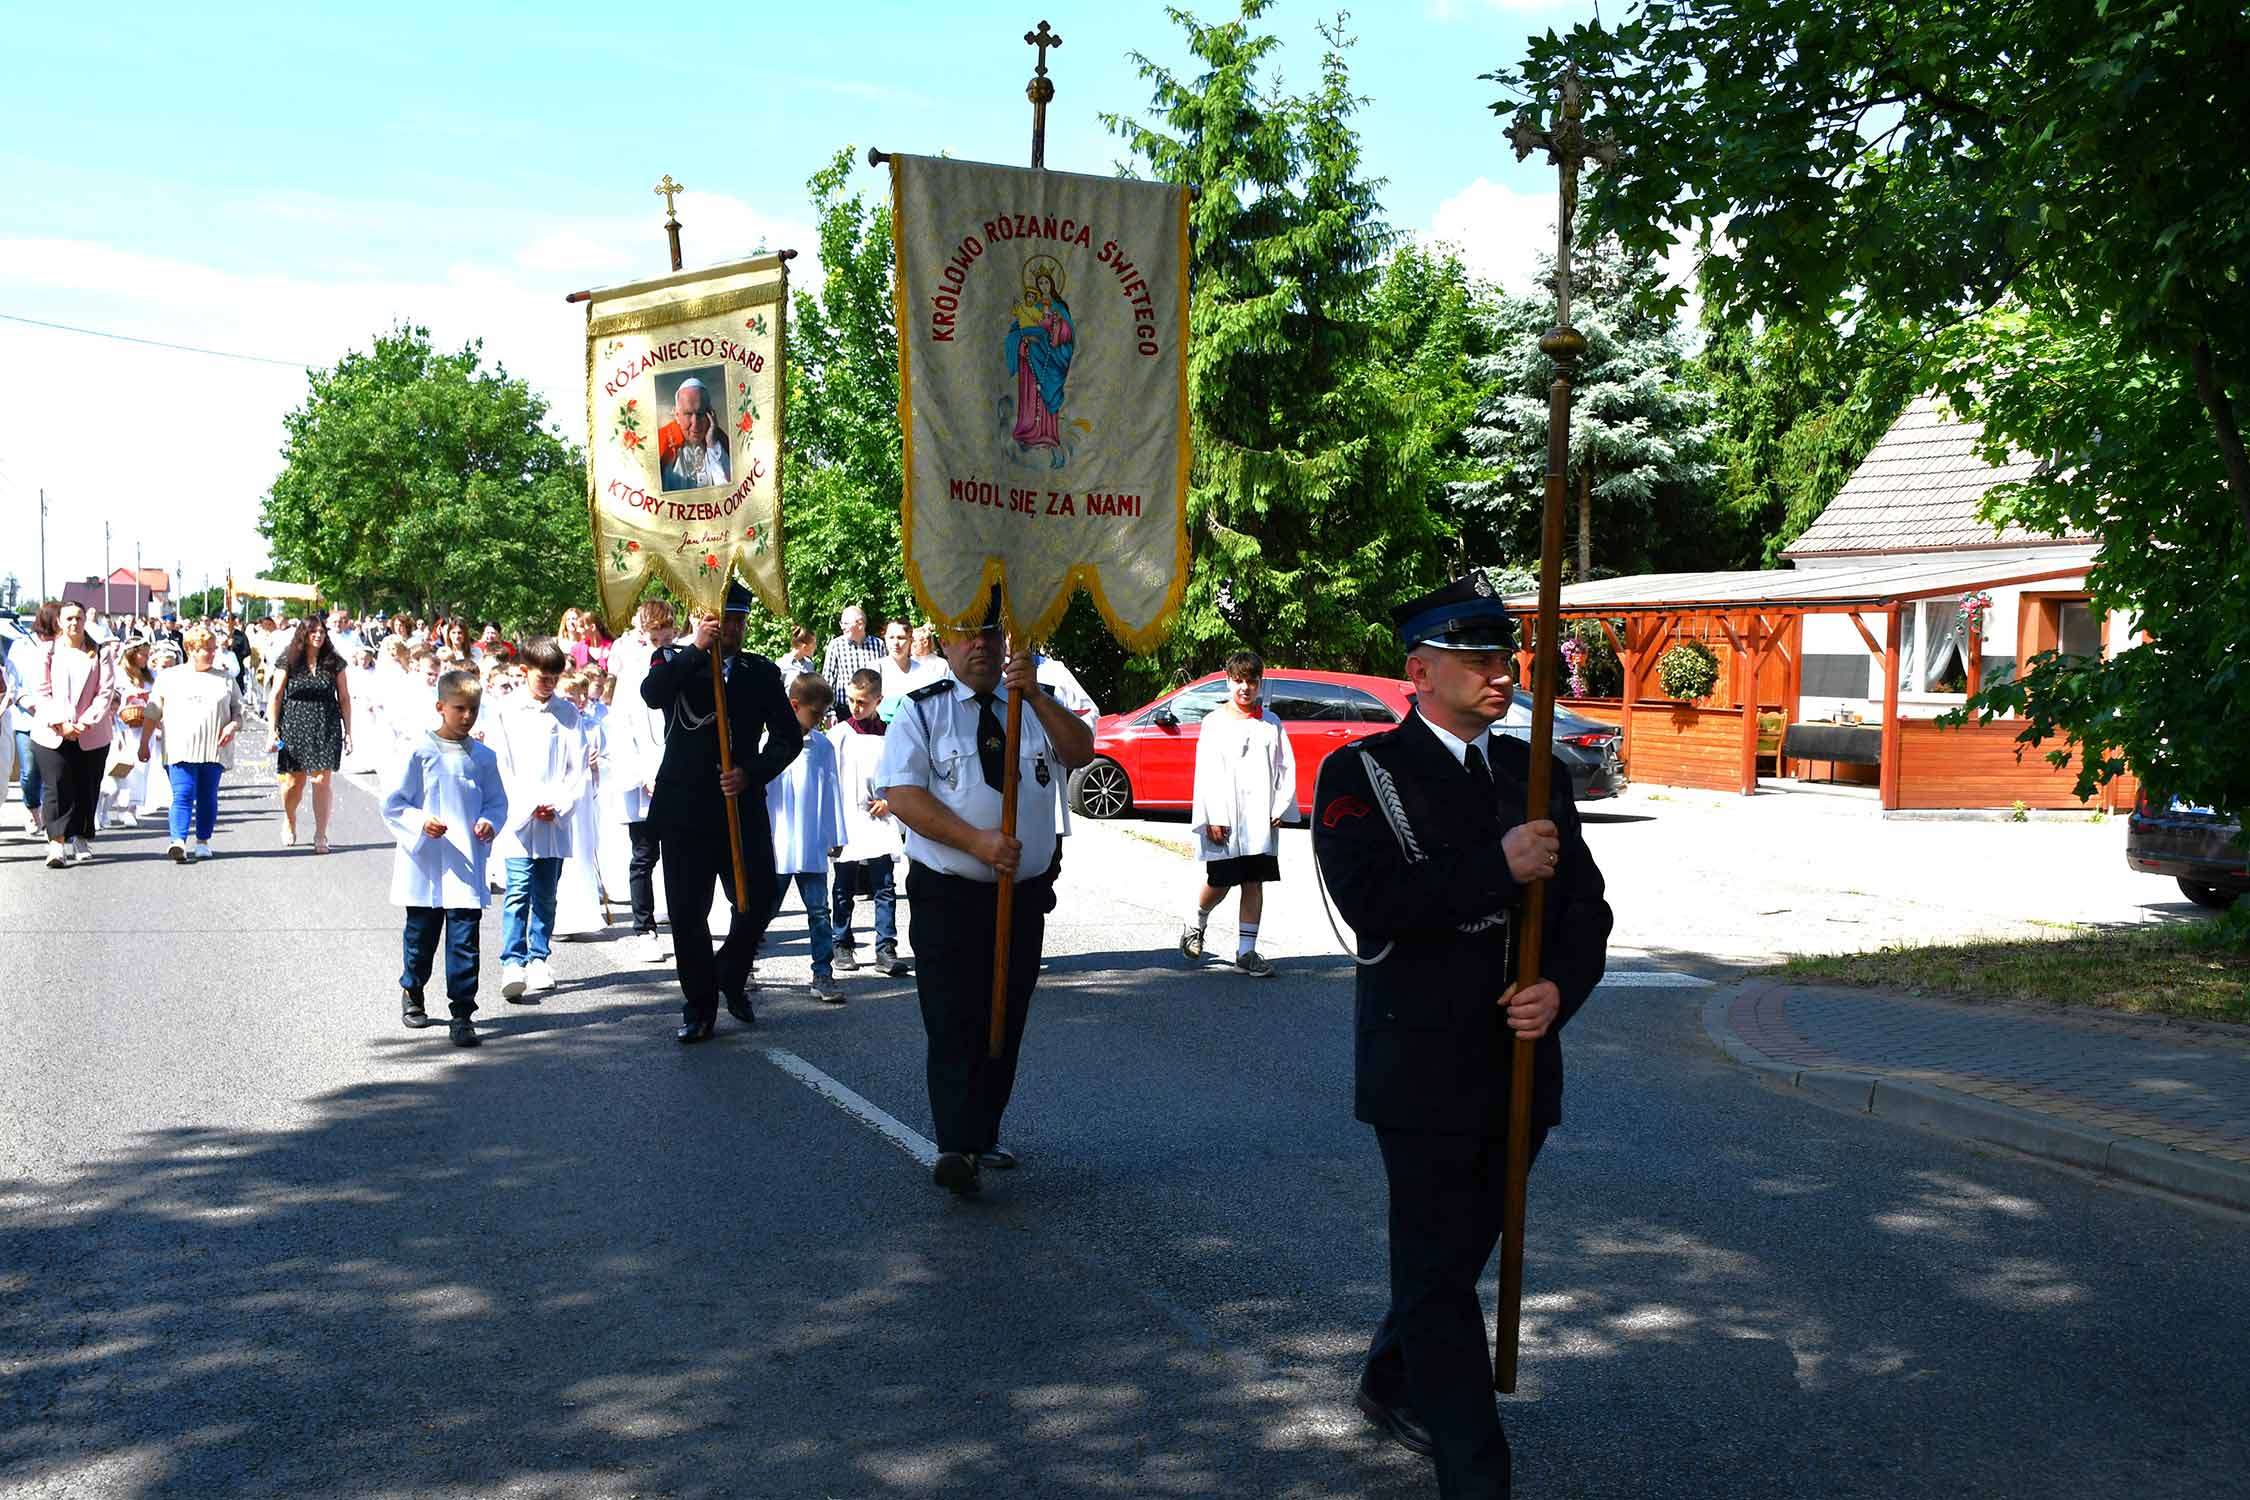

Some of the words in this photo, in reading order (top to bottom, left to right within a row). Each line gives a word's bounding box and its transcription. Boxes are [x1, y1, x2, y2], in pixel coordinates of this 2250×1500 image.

[932, 235, 984, 342] KRÓLOWO
[1097, 239, 1159, 356] ŚWIĘTEGO
[605, 339, 688, 397] RÓŻANIEC
[690, 338, 714, 357] TO
[720, 340, 765, 373] SKARB
[608, 479, 664, 515] KTÓRY
[667, 502, 722, 521] TRZEBA
[724, 458, 765, 515] ODKRYĆ
[950, 475, 1004, 508] MÓDL
[1009, 488, 1037, 518] SIĘ
[1045, 492, 1075, 516] ZA
[1086, 493, 1141, 517] NAMI
